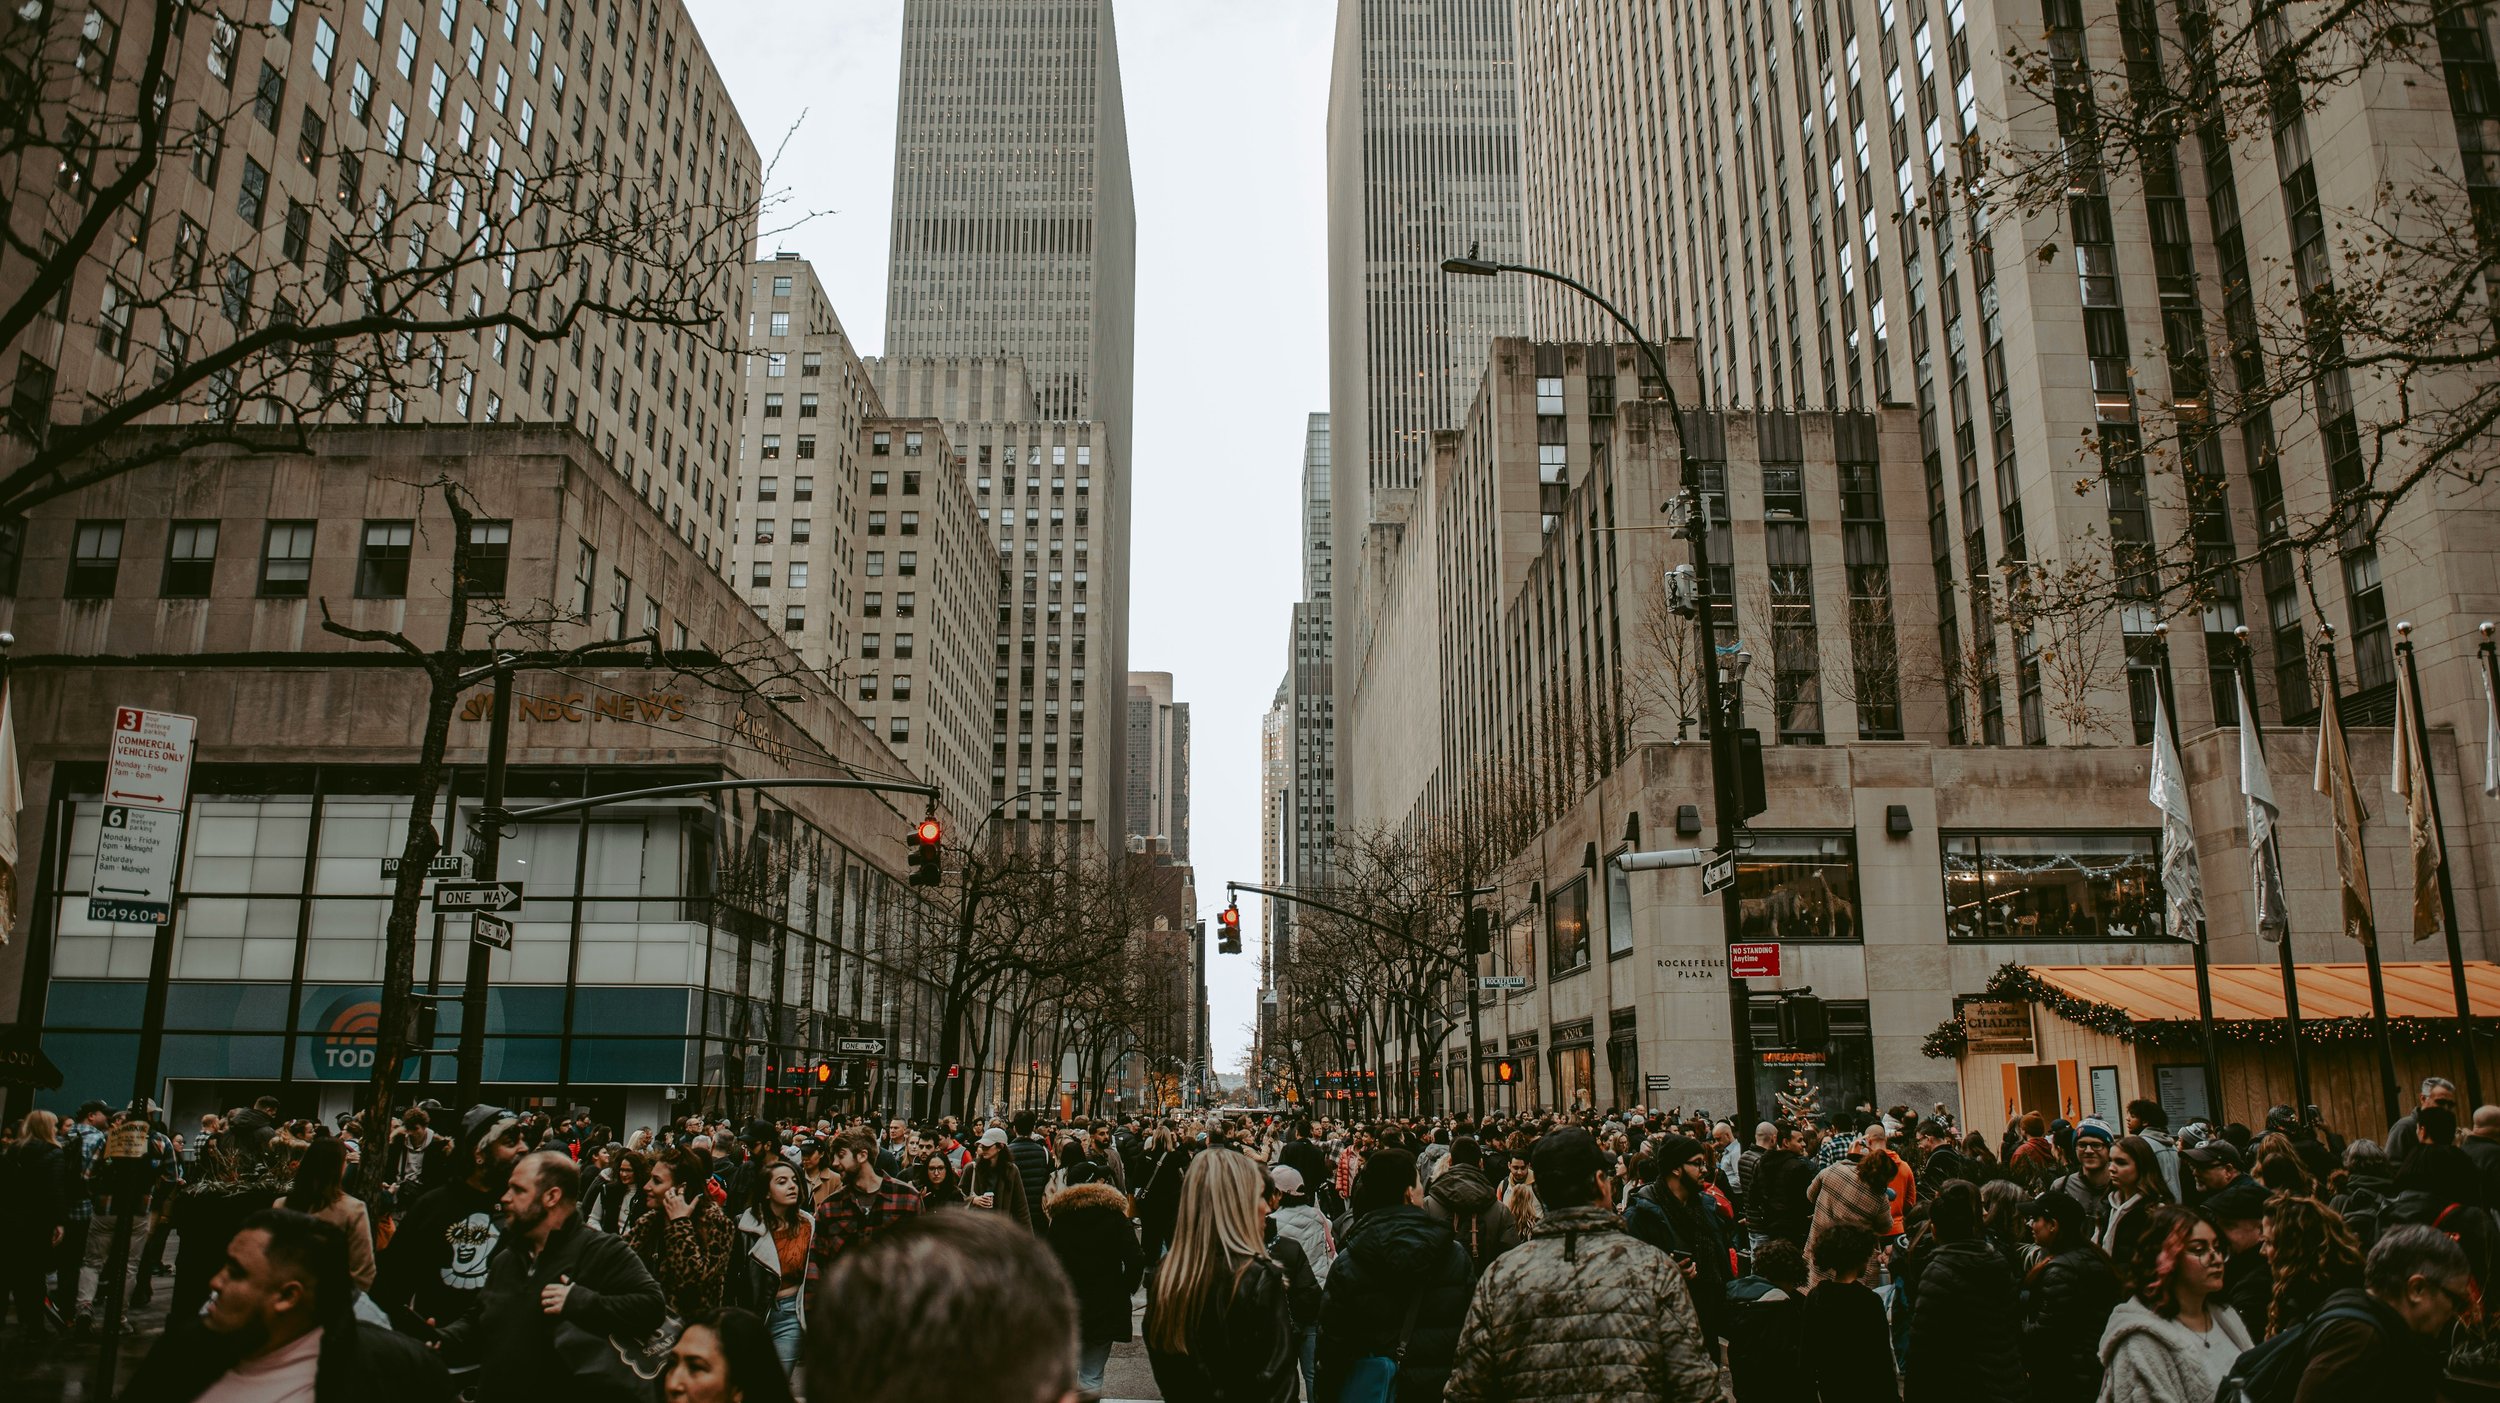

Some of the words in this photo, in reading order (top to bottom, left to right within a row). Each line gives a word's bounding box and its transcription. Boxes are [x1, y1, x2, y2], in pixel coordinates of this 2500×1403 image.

[519, 697, 584, 722] NBC
[595, 694, 687, 722] NEWS
[123, 711, 137, 730] 3
[145, 722, 171, 731] metered
[143, 728, 167, 737] parking
[118, 735, 176, 751] COMMERCIAL
[118, 746, 160, 759] VEHICLES
[162, 752, 185, 762] ONLY
[114, 760, 141, 769] Monday
[147, 763, 168, 773] Friday
[114, 768, 129, 776] 7am
[135, 771, 152, 779] 6pm
[108, 809, 122, 826] 6
[130, 818, 157, 826] metered
[129, 825, 153, 833] parking
[103, 833, 131, 842] Monday
[139, 836, 160, 845] Friday
[102, 842, 118, 850] 6pm
[125, 844, 153, 853] Midnight
[100, 854, 133, 863] Saturday
[99, 863, 115, 871] 8am
[121, 865, 150, 874] Midnight
[1707, 869, 1716, 885] ONE
[1720, 863, 1729, 875] WAY
[446, 892, 471, 903] ONE
[483, 891, 509, 903] WAY
[481, 922, 491, 936] ONE
[495, 927, 508, 940] WAY
[1733, 955, 1759, 963] Anytime
[1968, 1018, 2031, 1028] CHALETS
